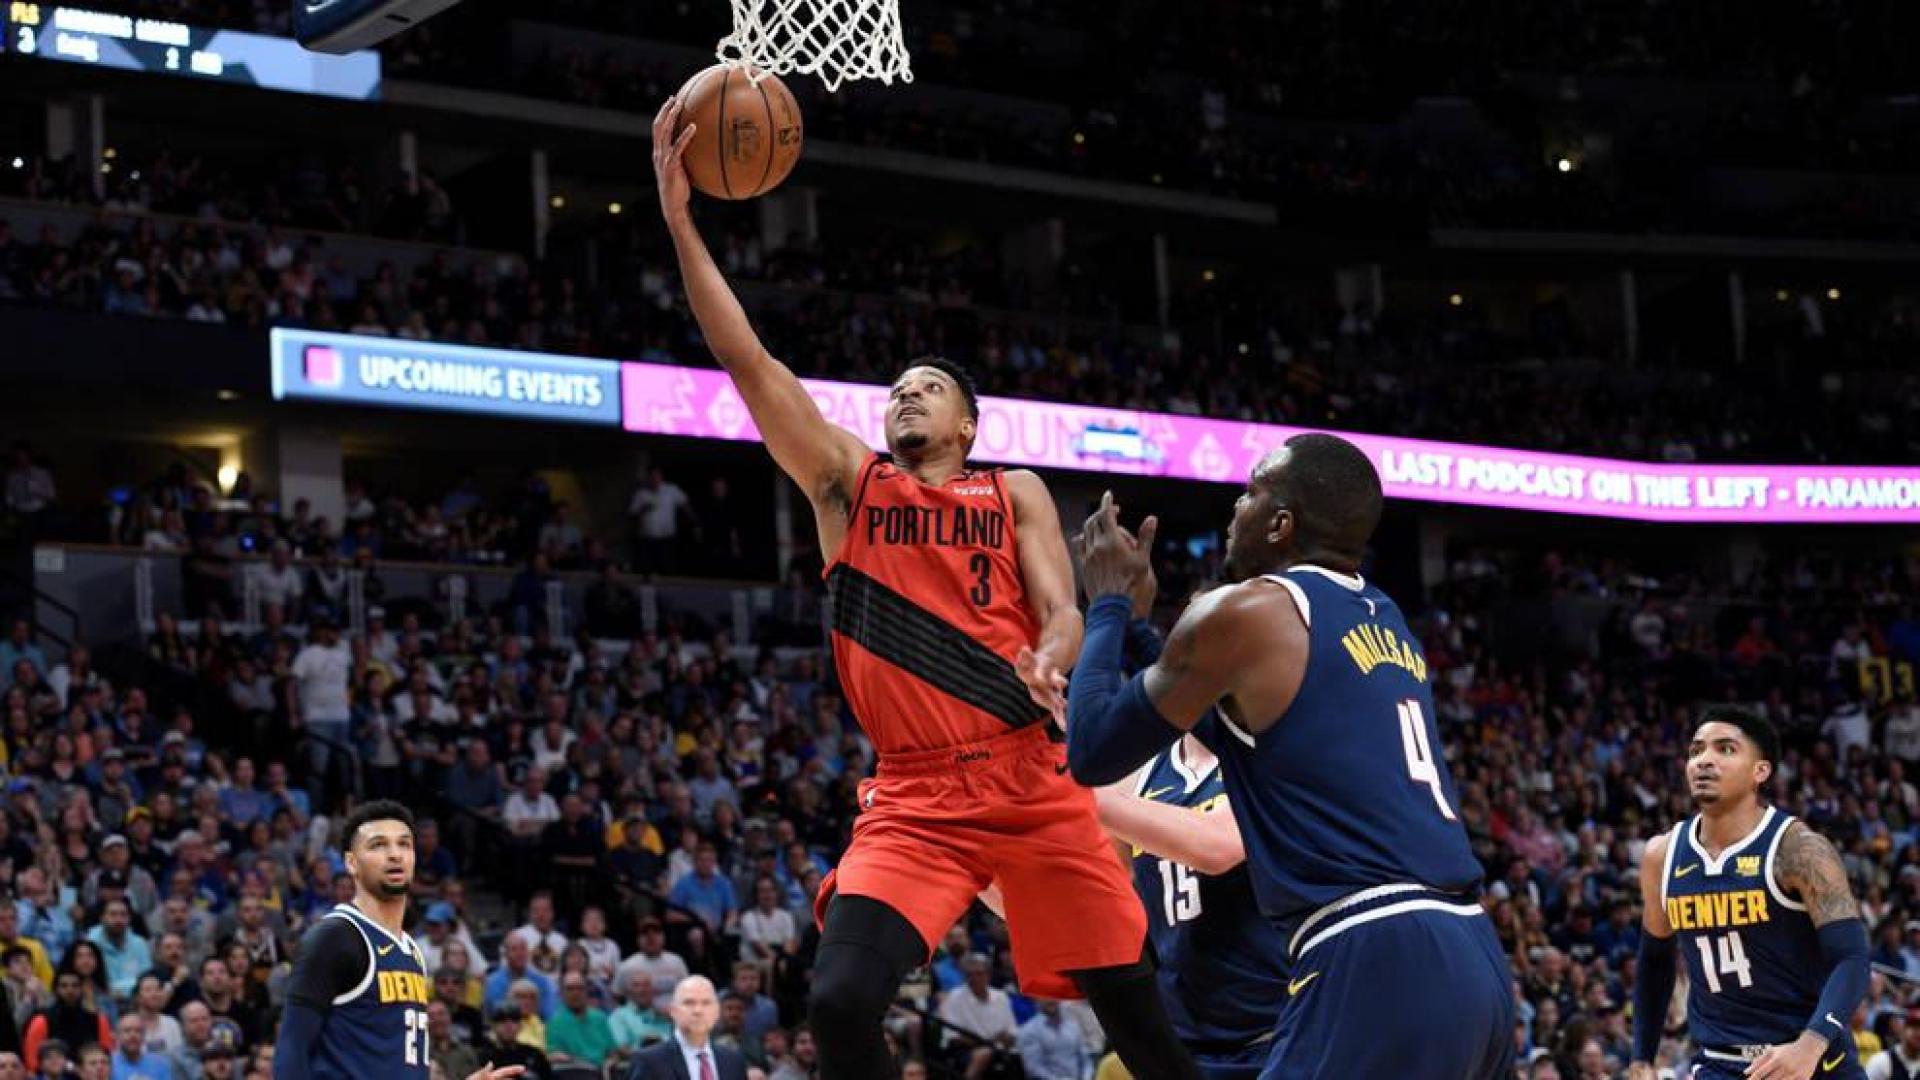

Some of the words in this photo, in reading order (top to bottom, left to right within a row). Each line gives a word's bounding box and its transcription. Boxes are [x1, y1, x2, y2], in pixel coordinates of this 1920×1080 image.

[359, 355, 503, 398] UPCOMING
[507, 367, 602, 407] EVENTS
[1382, 449, 1453, 487] LAST
[1457, 457, 1586, 500] PODCAST
[1590, 471, 1632, 504] ON
[1637, 475, 1690, 507] THE
[1697, 476, 1770, 508] LEFT
[866, 505, 1005, 549] PORTLAND
[969, 553, 993, 608] 3
[1396, 698, 1457, 821] 4
[1158, 858, 1203, 928] 15
[1667, 888, 1770, 931] DENVER
[1696, 930, 1754, 994] 14
[404, 1007, 430, 1066] 27
